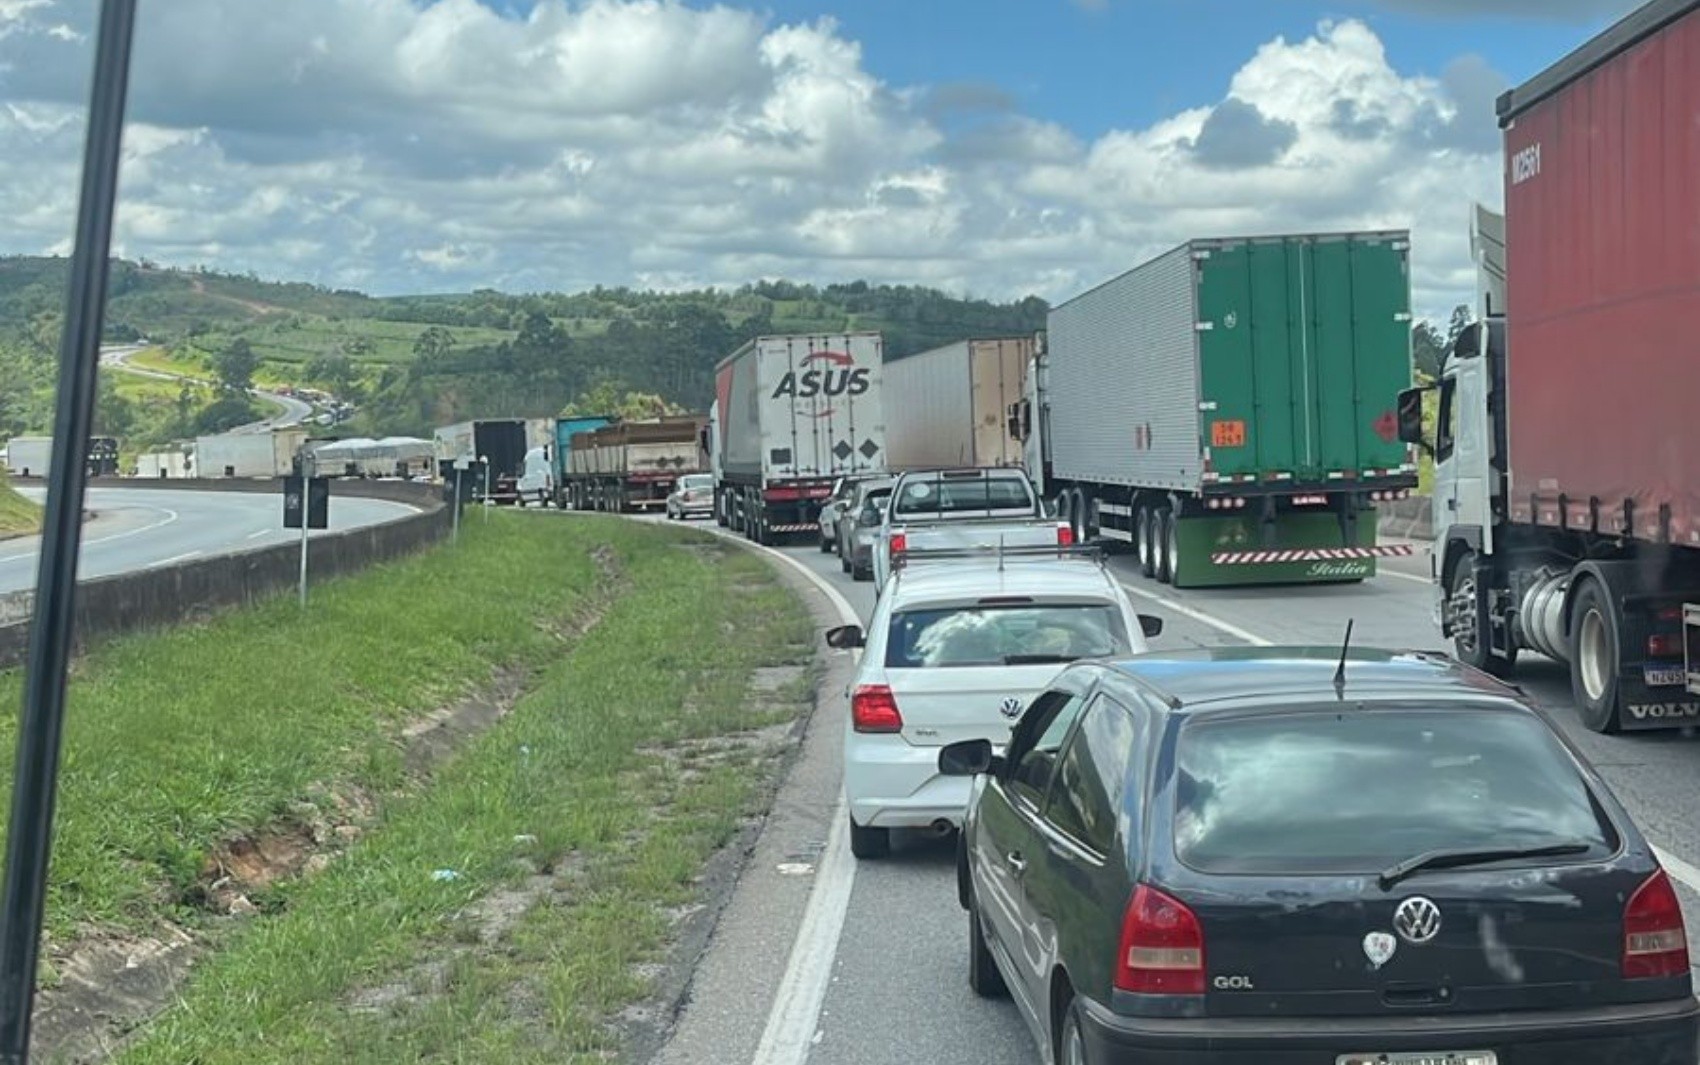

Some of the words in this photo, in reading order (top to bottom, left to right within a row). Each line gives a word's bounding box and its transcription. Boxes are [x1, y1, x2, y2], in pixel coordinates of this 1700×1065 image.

[771, 368, 870, 399] ASUS
[1628, 702, 1700, 719] VOLV
[1394, 896, 1441, 942] VW
[1214, 976, 1254, 989] GOL
